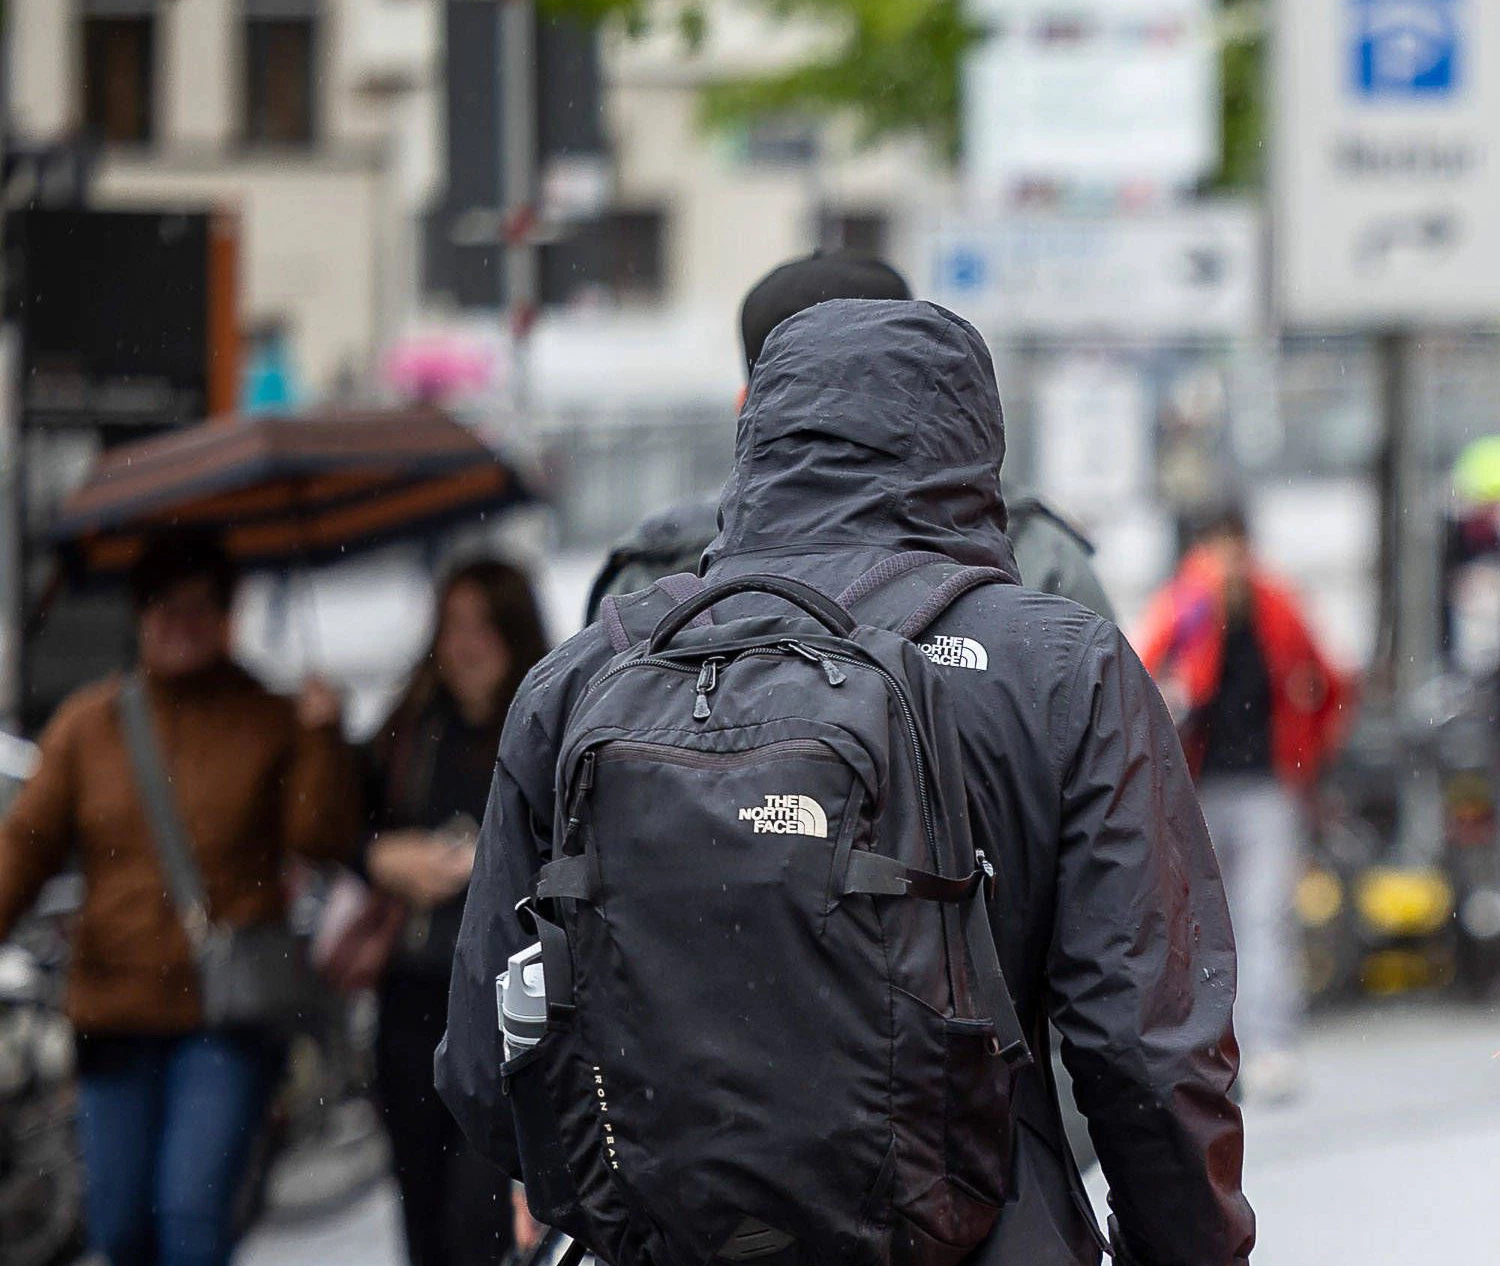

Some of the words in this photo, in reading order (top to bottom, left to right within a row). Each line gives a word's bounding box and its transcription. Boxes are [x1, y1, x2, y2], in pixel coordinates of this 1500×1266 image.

[934, 635, 963, 647] THE
[917, 643, 962, 657] ORTH
[764, 794, 799, 808] THE
[738, 806, 798, 820] NORTH
[753, 820, 798, 834] FACE
[593, 1065, 608, 1111] IRON
[603, 1123, 619, 1170] PEAK
